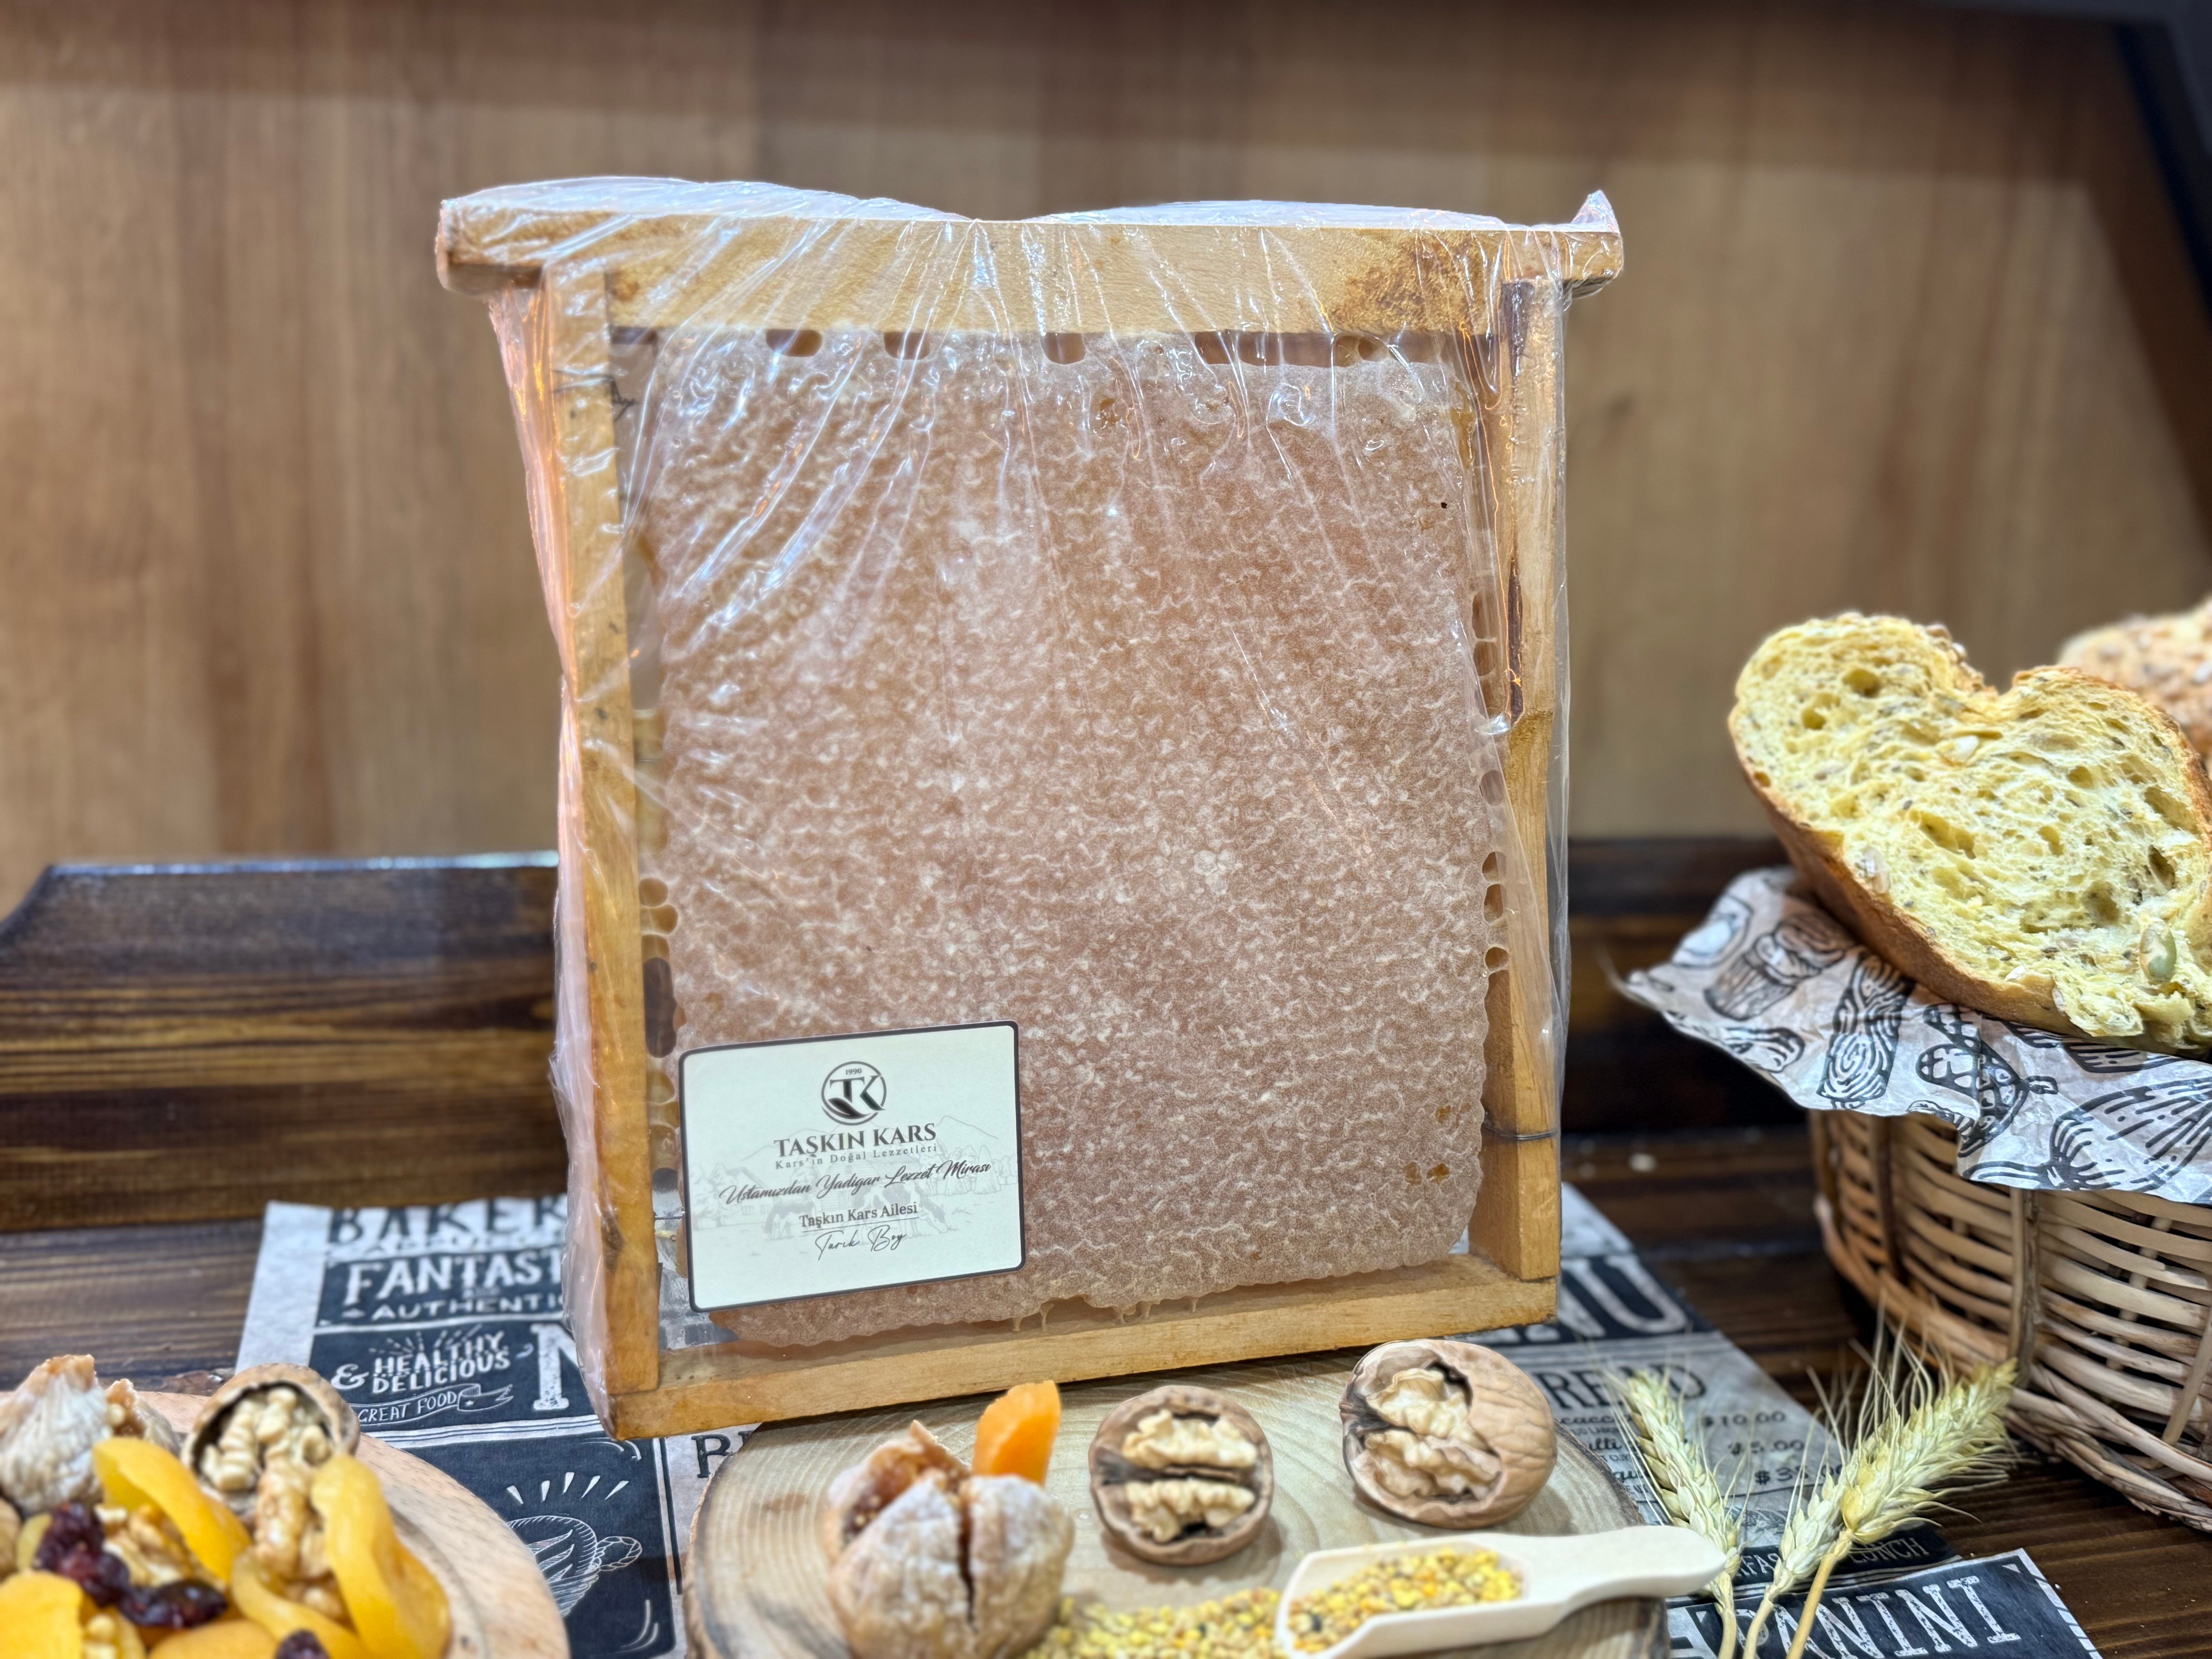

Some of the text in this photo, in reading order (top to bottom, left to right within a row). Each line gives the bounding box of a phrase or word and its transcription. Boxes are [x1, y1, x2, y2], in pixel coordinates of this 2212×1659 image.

[773, 1123, 937, 1158] TAŞKIN KARS
[830, 1151, 866, 1164] Doğal
[873, 1143, 937, 1158] Lezzetleri
[816, 1173, 881, 1199] Yadigar
[884, 1163, 937, 1188] Lezzet
[936, 1160, 991, 1179] Mirası
[799, 1202, 918, 1228] Taşkın Kars Ailesi
[867, 1224, 907, 1252] Boy
[375, 1330, 505, 1374] HEALTHY
[330, 1350, 511, 1394] & DELICIOUS
[359, 1391, 457, 1423] GREAT FOOD
